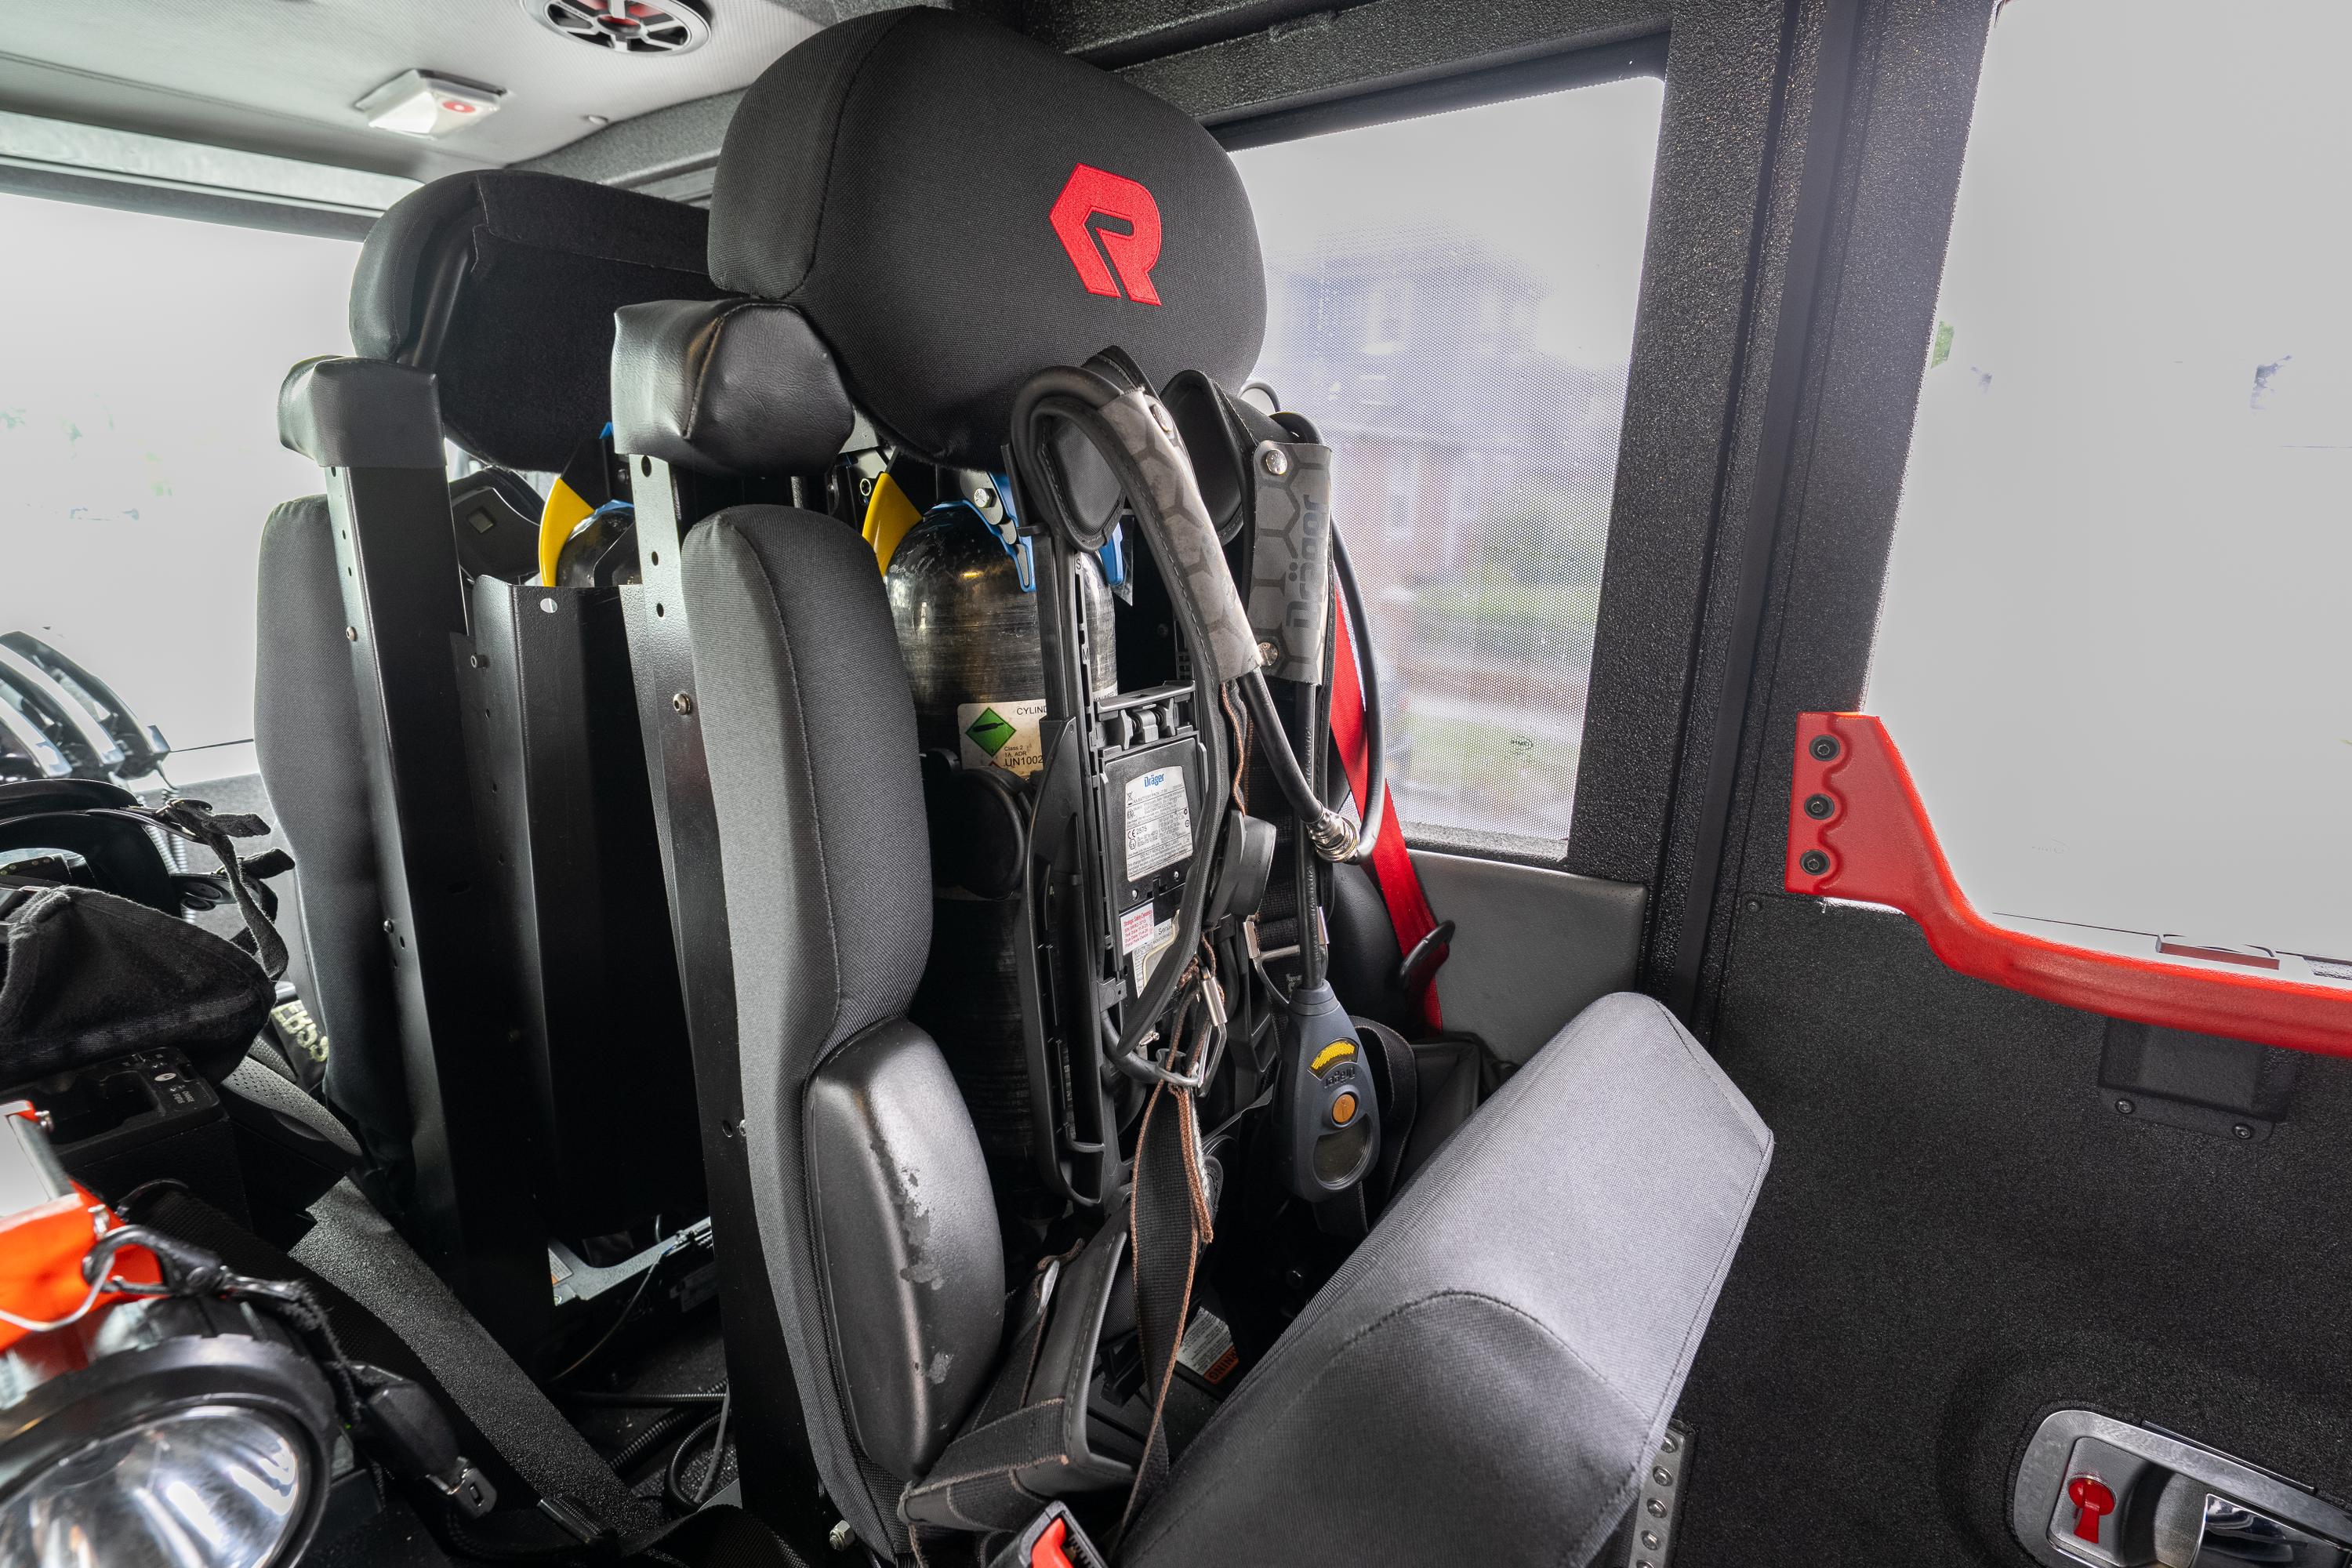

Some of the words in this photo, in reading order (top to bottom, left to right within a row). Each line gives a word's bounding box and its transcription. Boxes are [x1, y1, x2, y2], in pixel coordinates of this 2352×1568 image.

[1049, 163, 1162, 306] R
[1076, 557, 1082, 570] S
[1083, 648, 1090, 661] M
[1004, 755, 1044, 767] UN1002
[1144, 774, 1165, 787] Dräger
